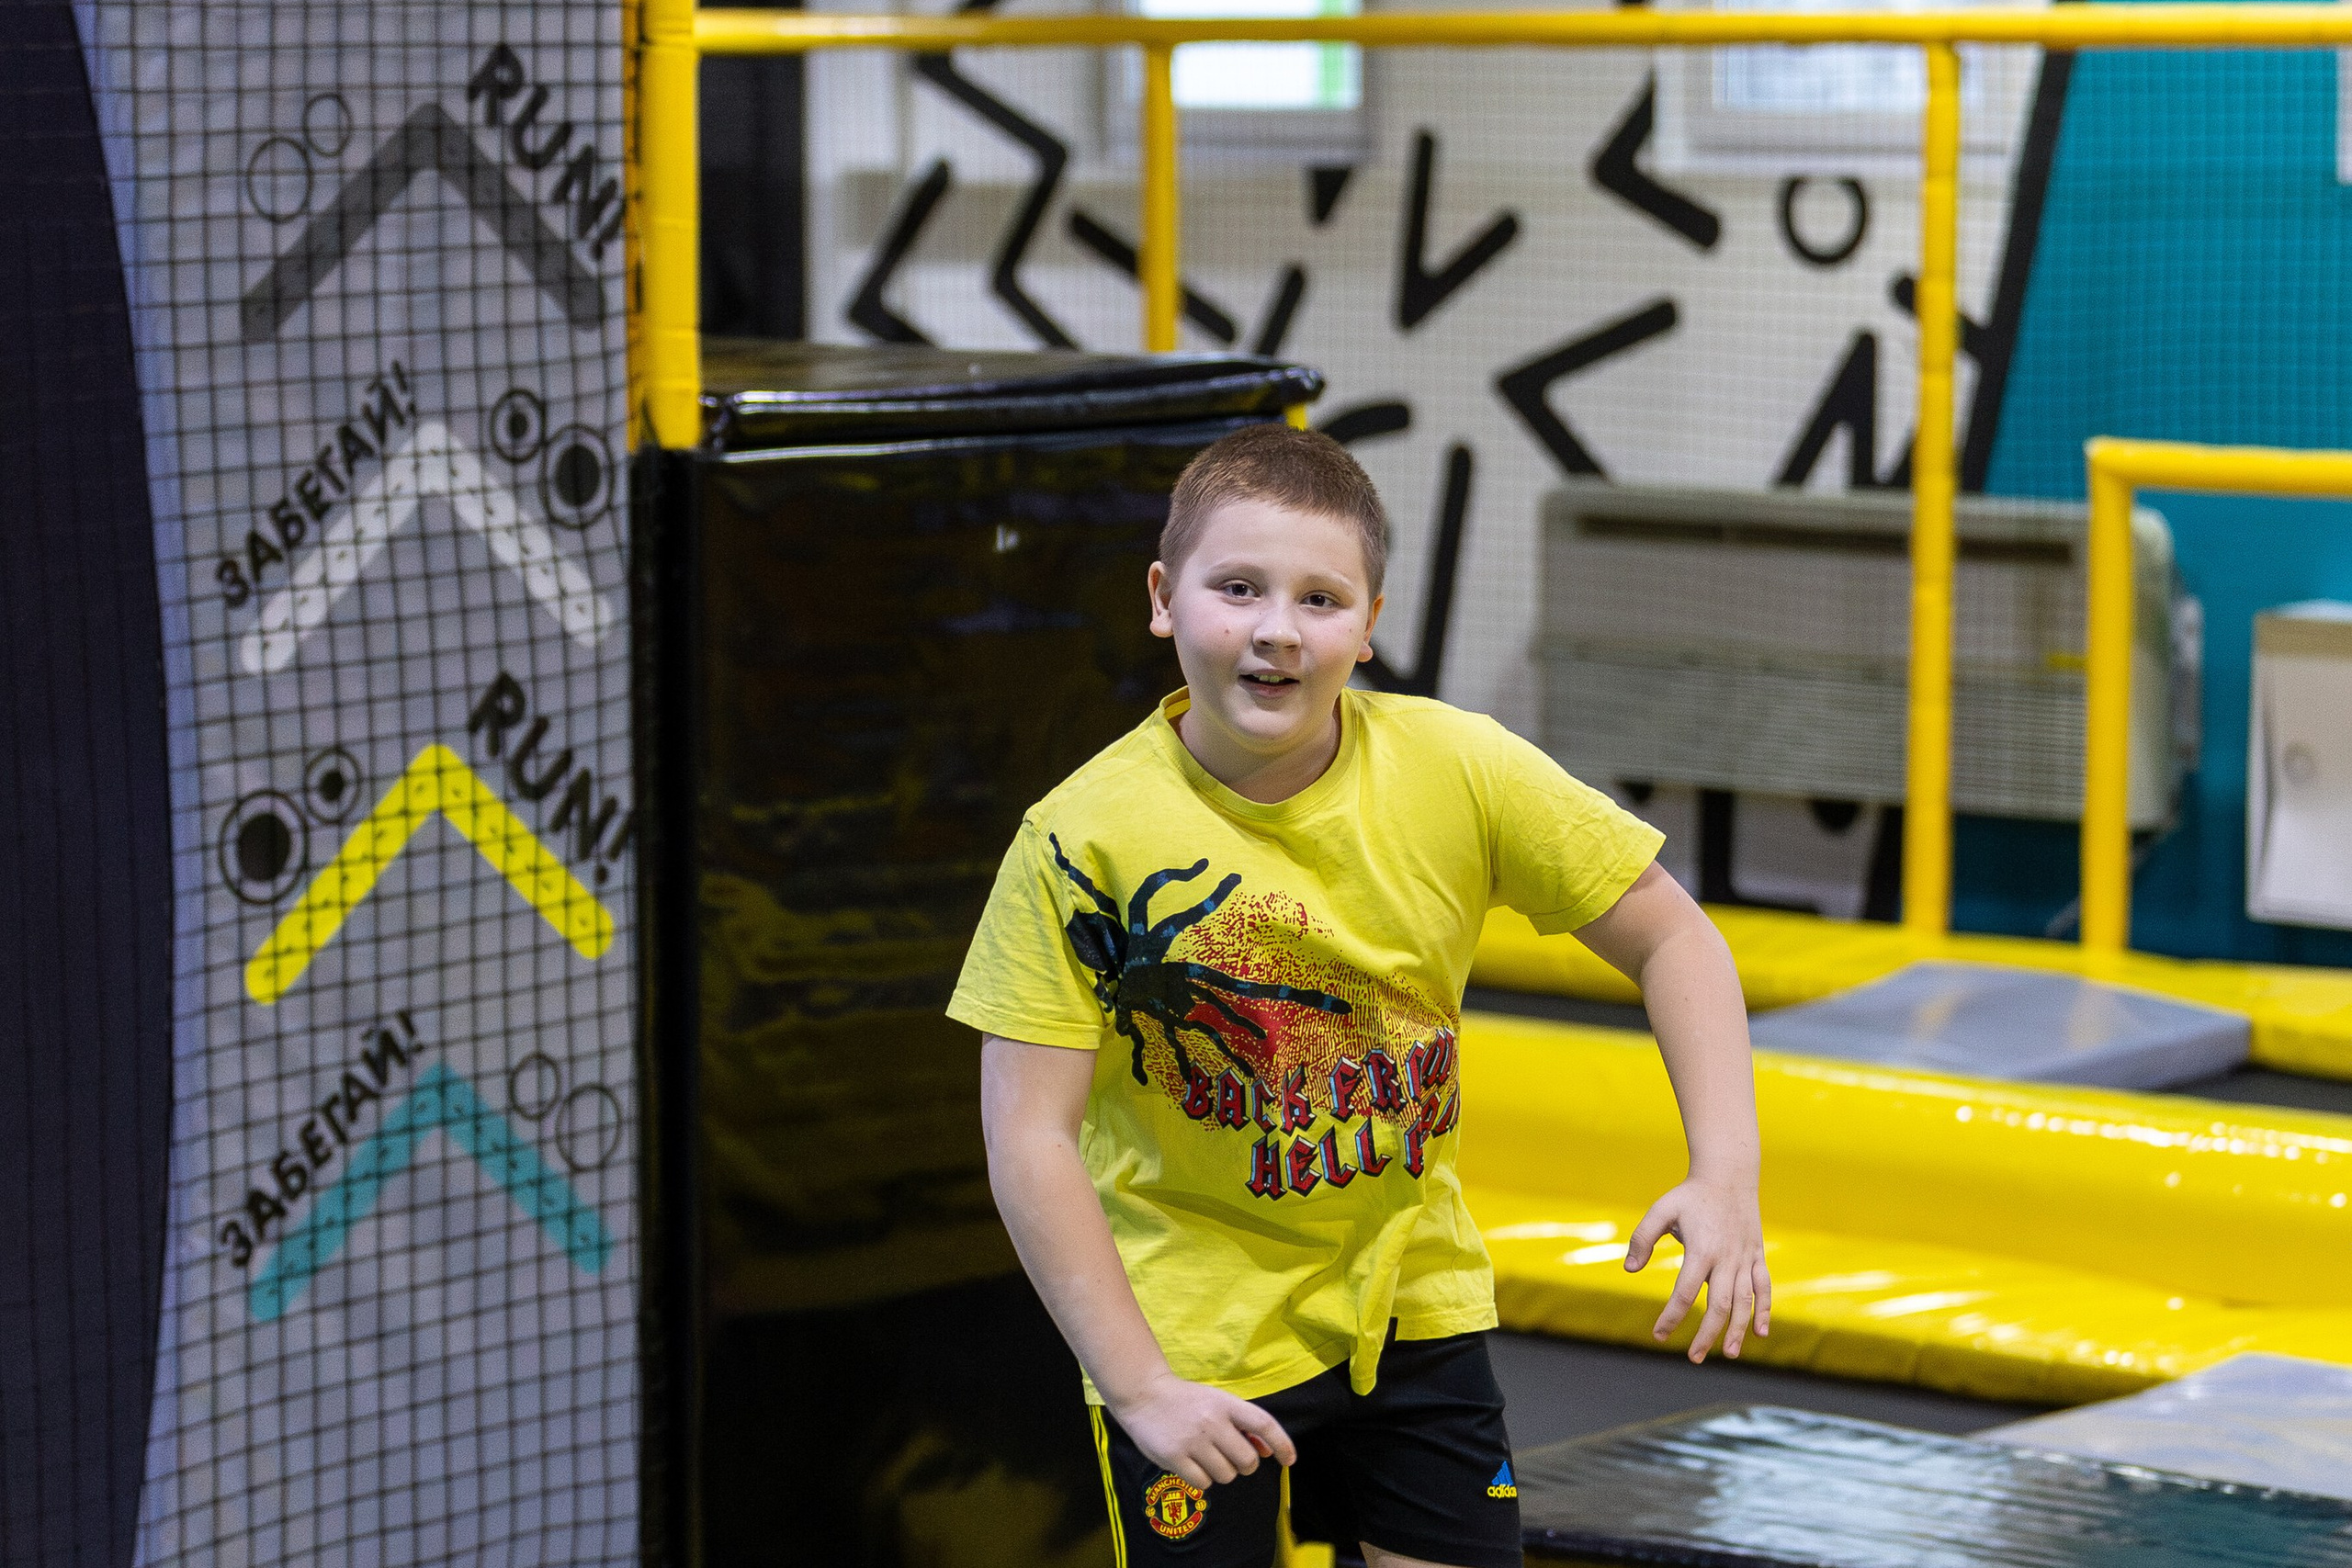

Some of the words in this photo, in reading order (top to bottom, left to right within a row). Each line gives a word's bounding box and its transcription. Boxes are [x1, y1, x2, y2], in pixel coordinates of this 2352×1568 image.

[468, 43, 626, 261] RUN!
[215, 359, 417, 608] ЗАБЕГАЙ!
[469, 671, 635, 885] RUN!
[220, 1010, 425, 1267] ЗАБЕГАЙ!
[1181, 1060, 1317, 1137] BACK
[1245, 1116, 1393, 1201] HELL
[1159, 1520, 1194, 1535] UNITED
[1487, 1483, 1517, 1498] adida
